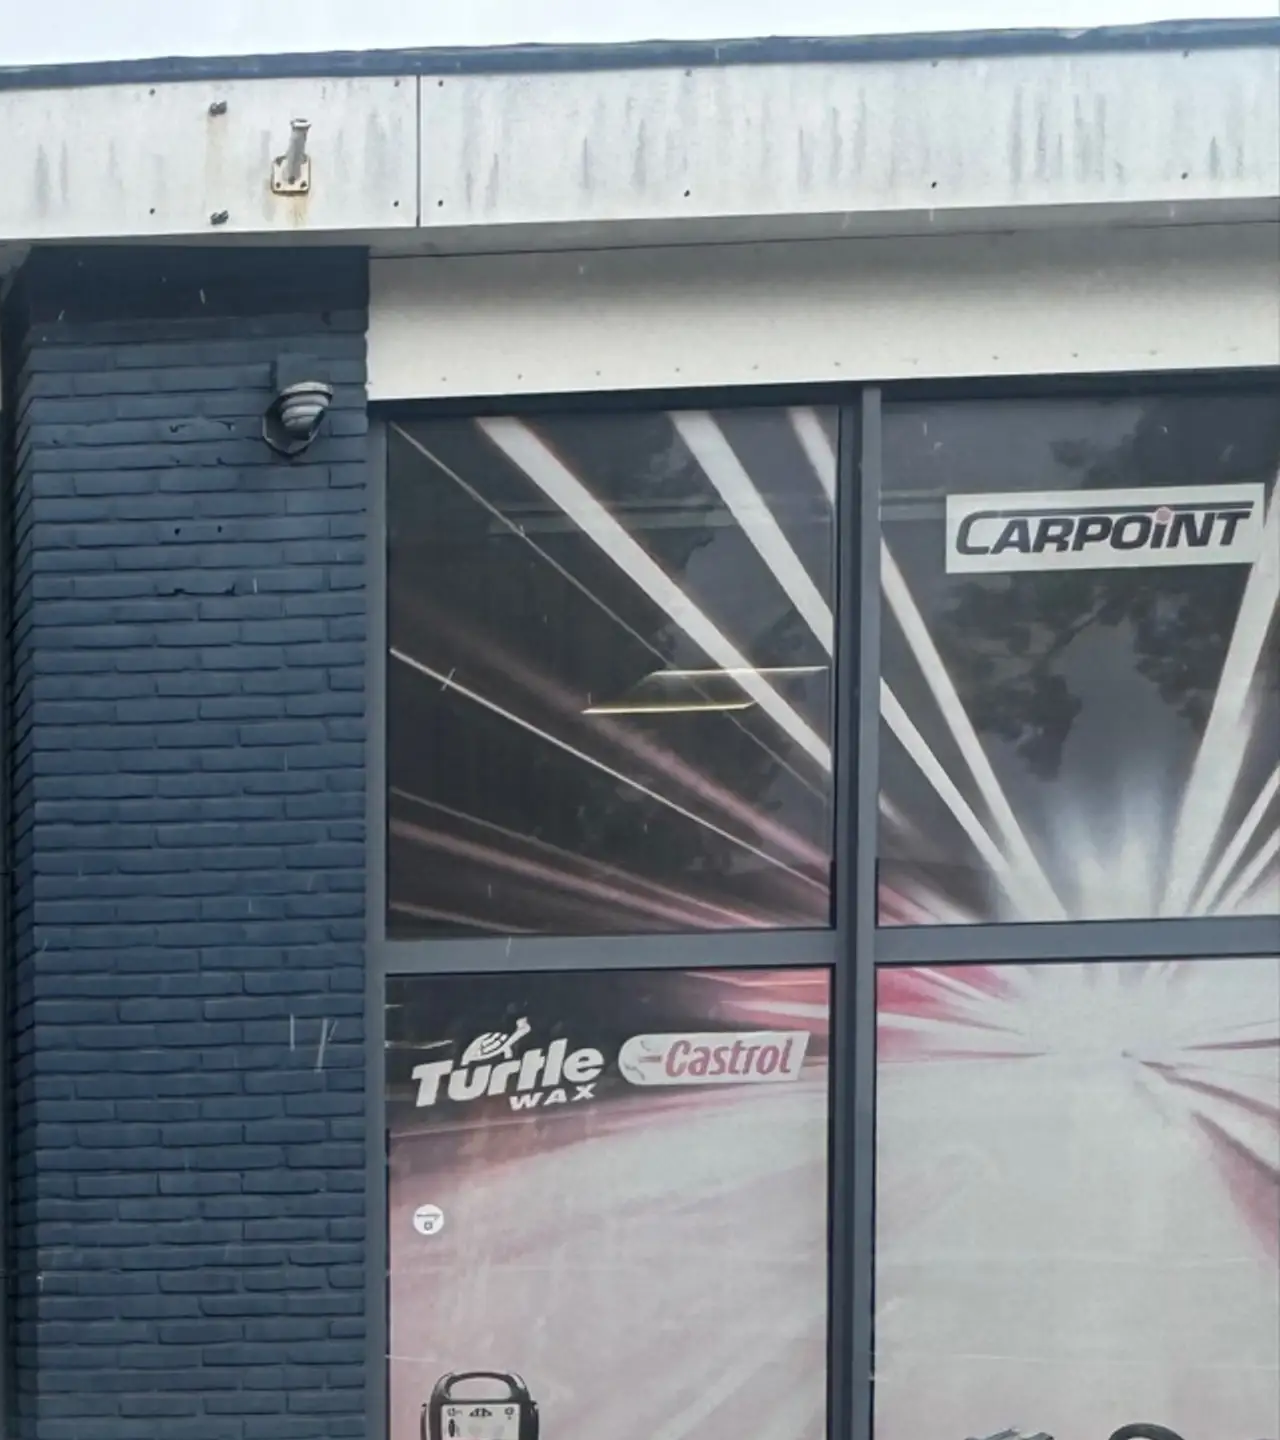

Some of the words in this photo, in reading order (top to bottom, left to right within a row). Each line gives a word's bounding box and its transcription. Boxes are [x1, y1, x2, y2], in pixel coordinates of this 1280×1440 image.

[411, 1037, 605, 1108] Turtle
[665, 1038, 794, 1078] Castrol
[509, 1082, 598, 1112] WAX
